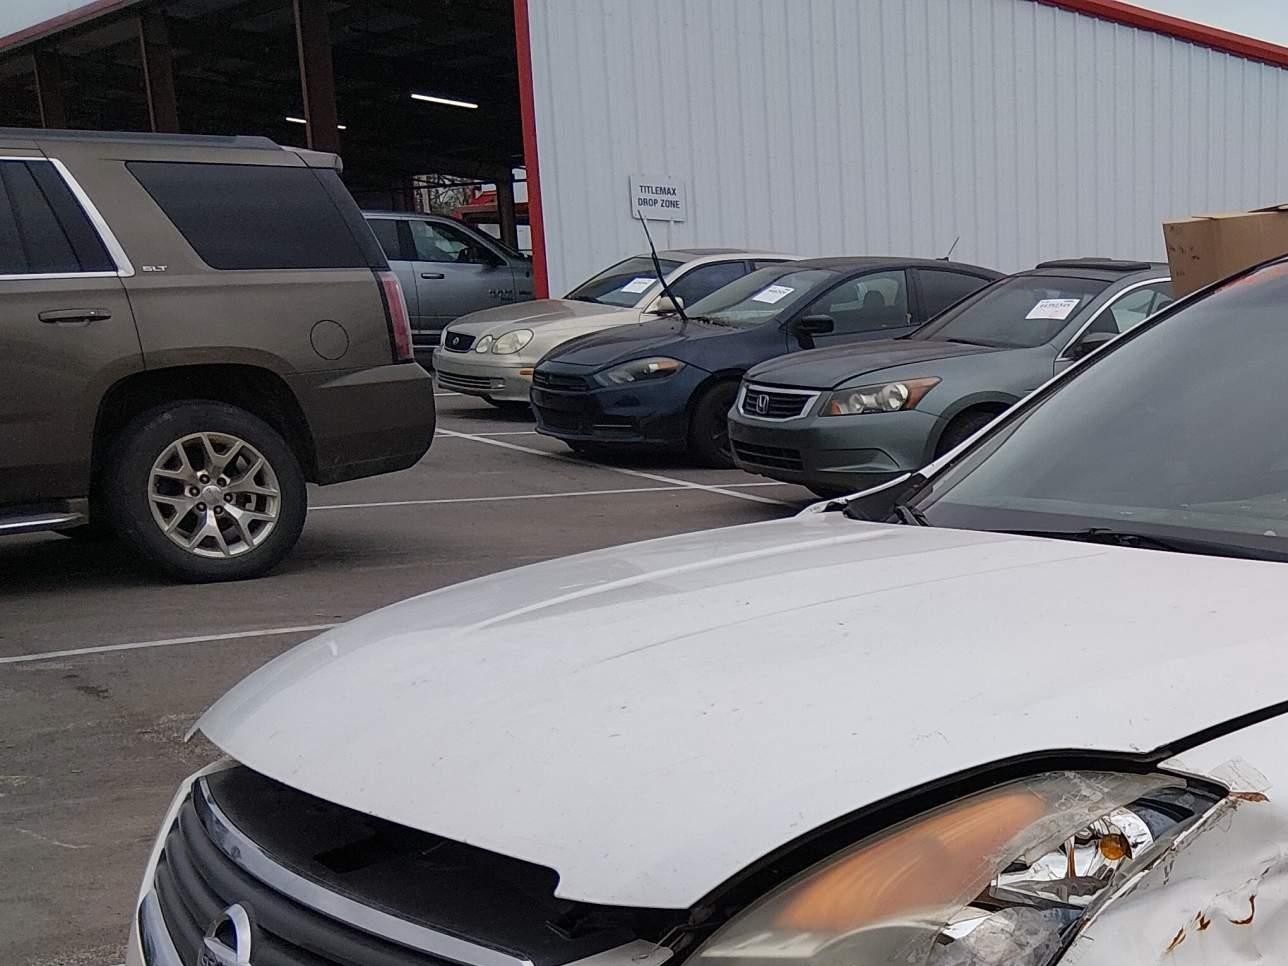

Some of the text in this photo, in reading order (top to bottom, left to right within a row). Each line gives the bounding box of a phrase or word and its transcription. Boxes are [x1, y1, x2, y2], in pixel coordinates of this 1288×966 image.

[639, 185, 677, 196] TITLEMAX
[638, 198, 681, 208] DROP ZONE
